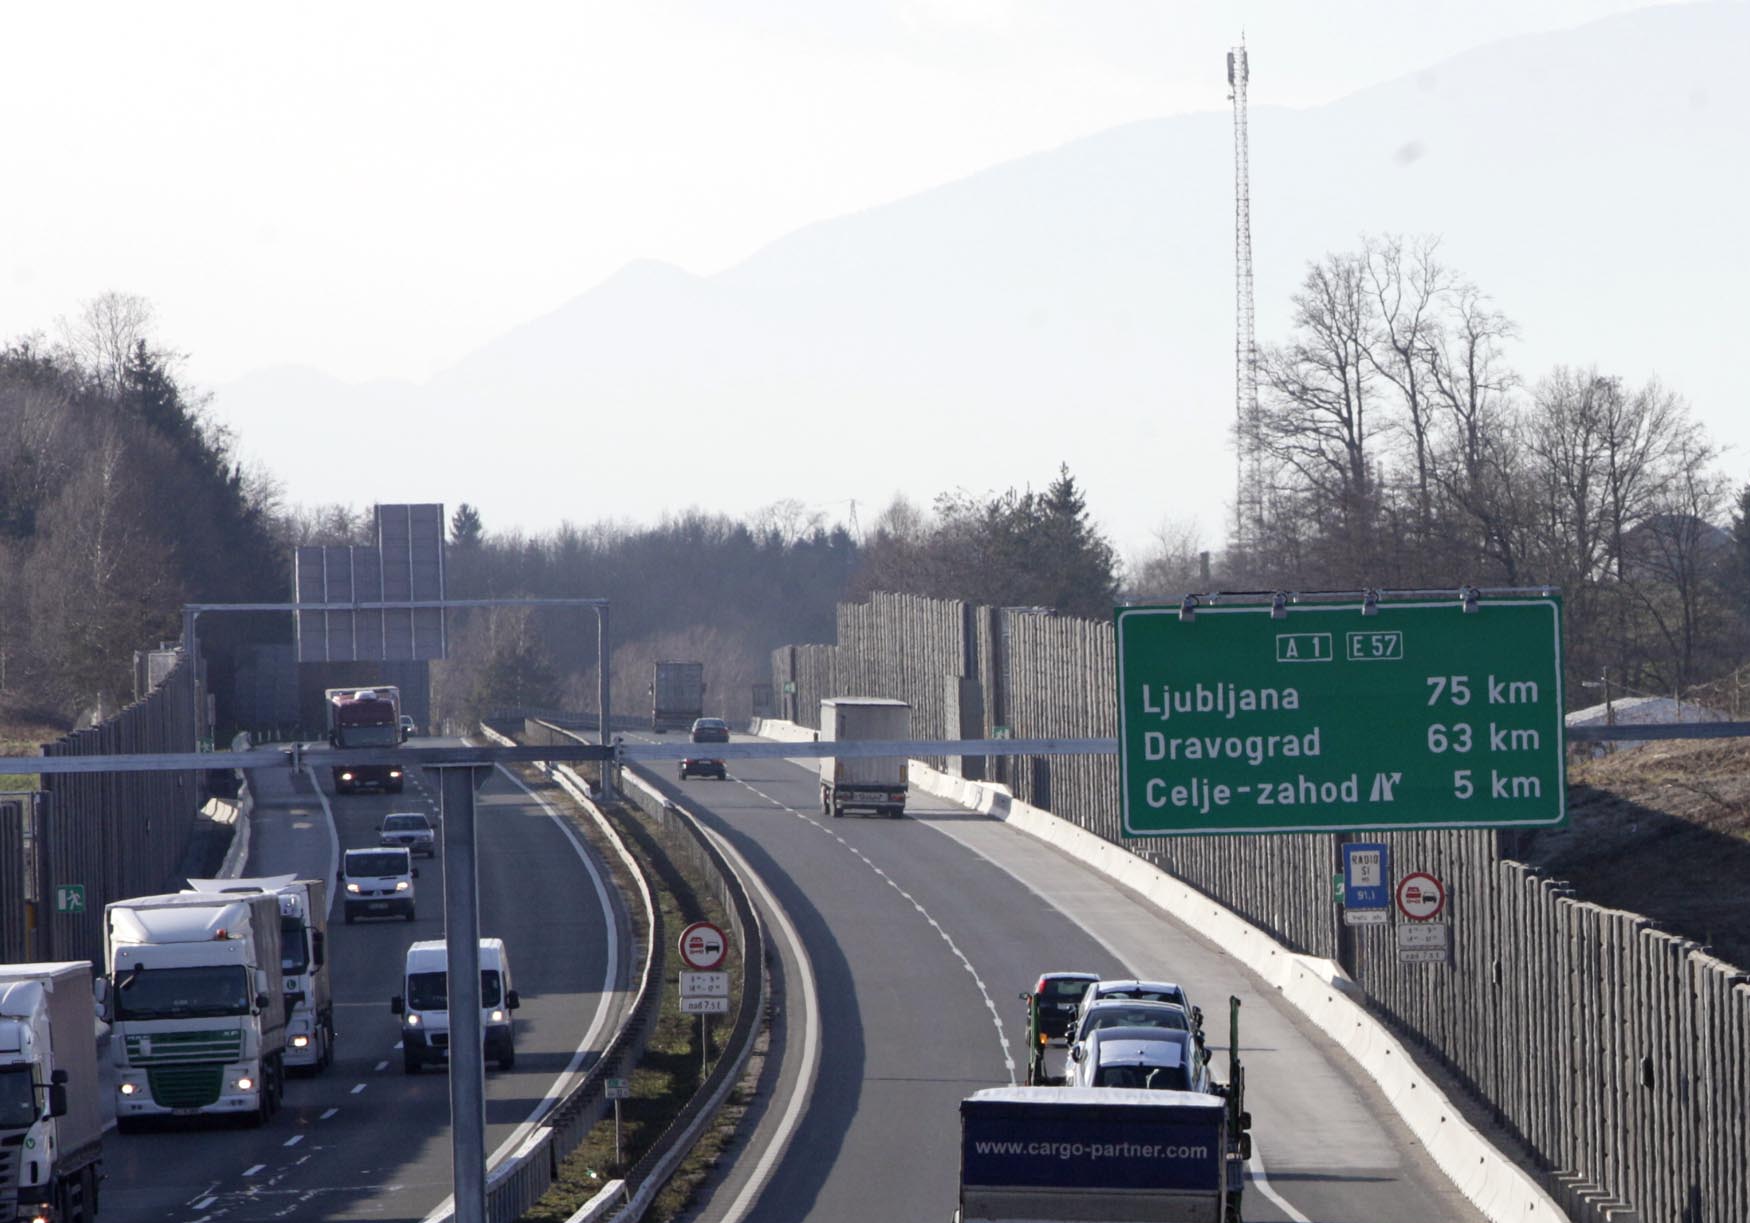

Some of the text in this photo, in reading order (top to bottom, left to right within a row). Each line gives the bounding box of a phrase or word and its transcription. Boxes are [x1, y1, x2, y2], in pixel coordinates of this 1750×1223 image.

[1286, 637, 1320, 658] A 1
[1353, 635, 1397, 657] E 57
[1143, 675, 1538, 720] Ljubljana 75 km
[1145, 722, 1540, 765] Dravograd 63 km
[1454, 770, 1474, 799] 5
[1491, 769, 1541, 798] km
[1352, 855, 1379, 865] RADIO
[975, 1140, 1208, 1160] www.cargo-partner.com
